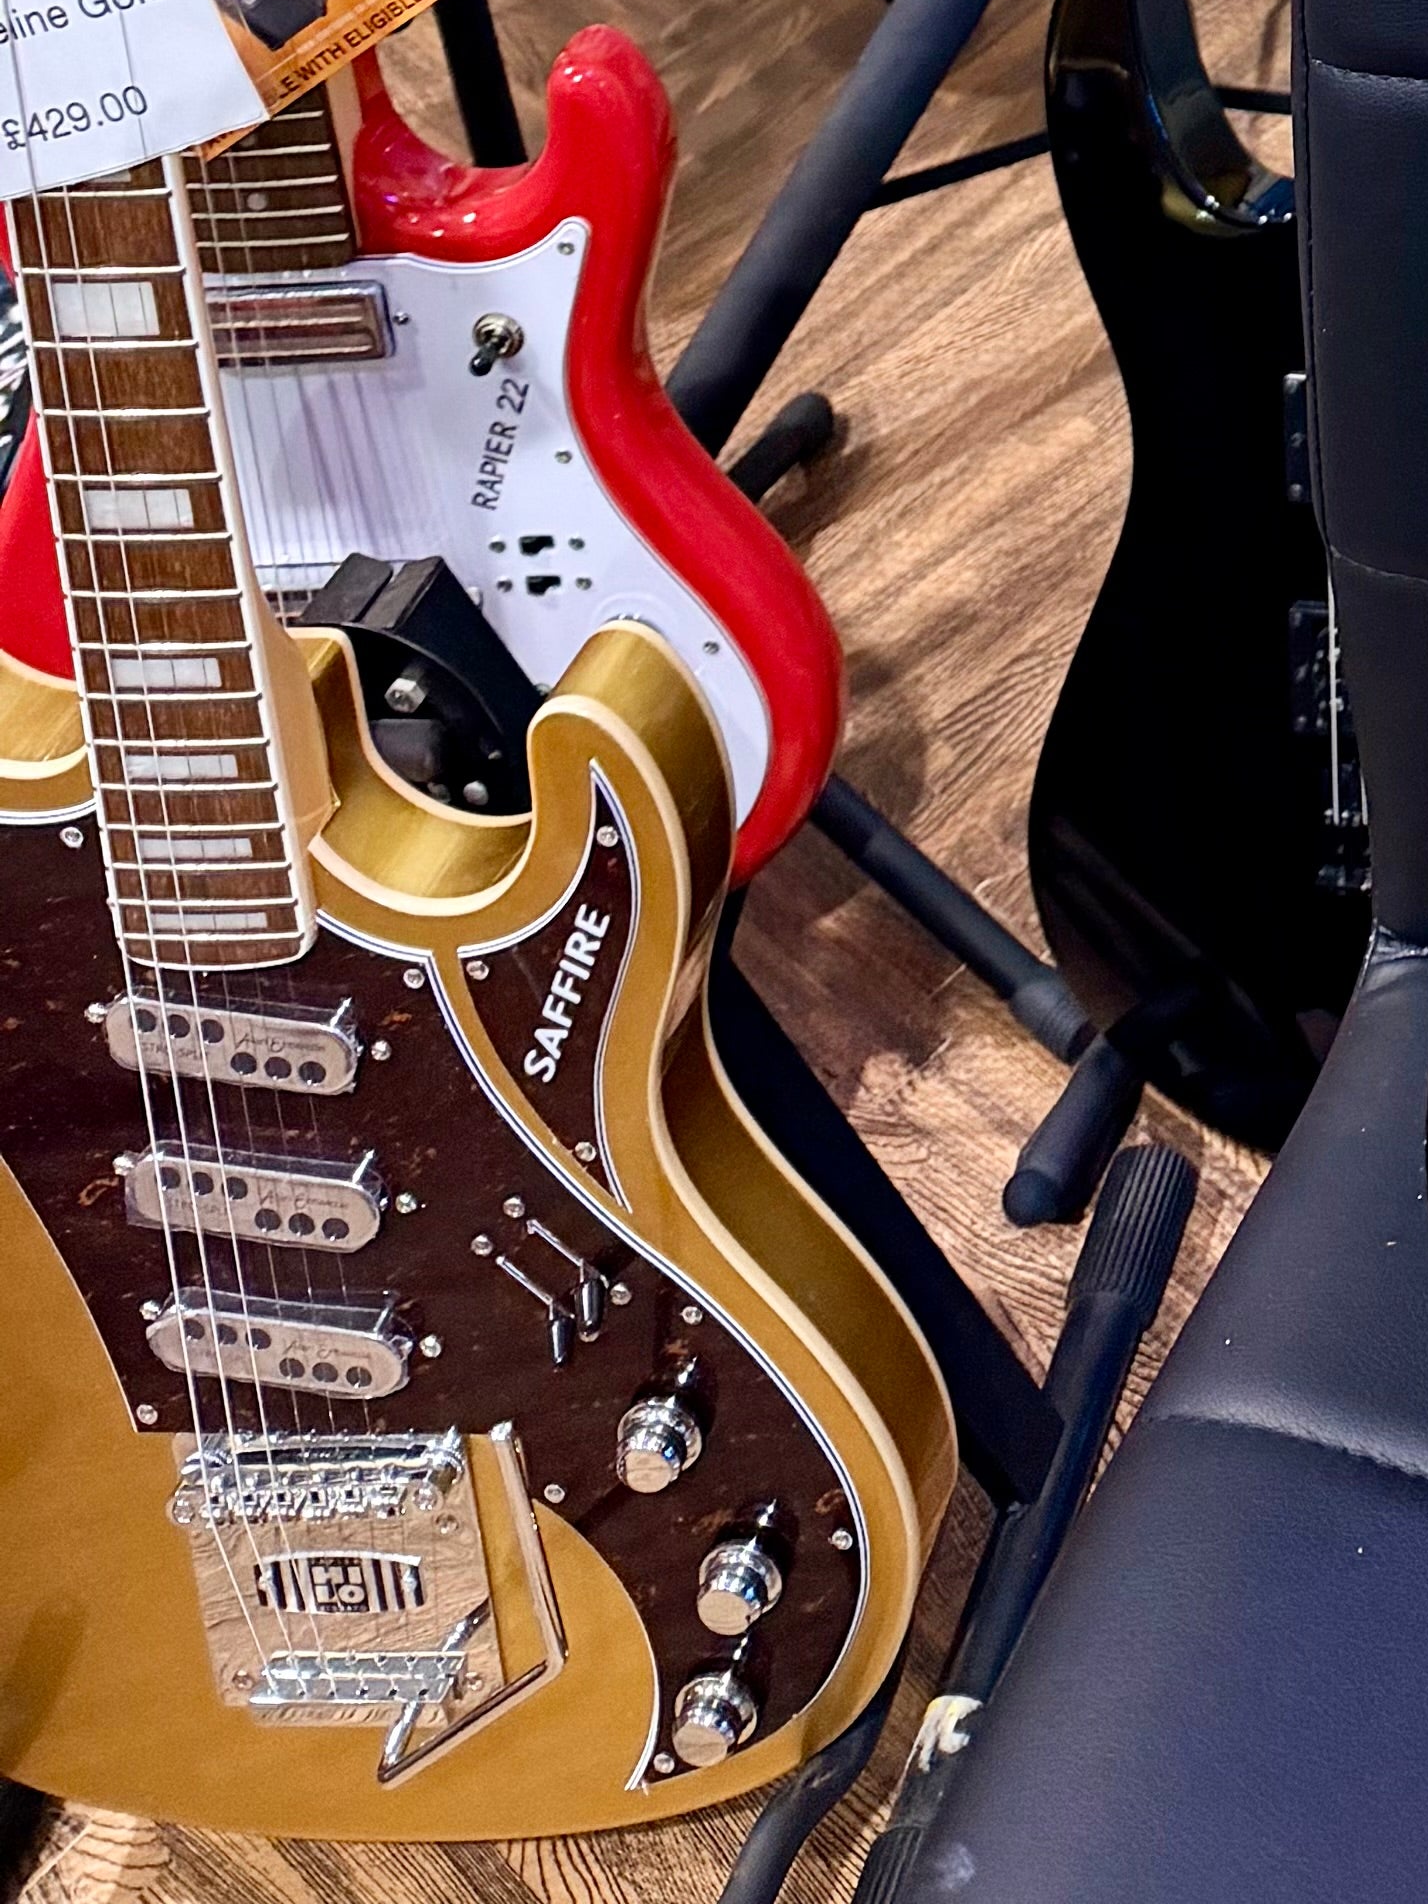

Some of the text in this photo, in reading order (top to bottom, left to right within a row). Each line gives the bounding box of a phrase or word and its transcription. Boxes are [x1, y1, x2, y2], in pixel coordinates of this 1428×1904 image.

[293, 42, 347, 82] WITH
[2, 83, 149, 151] £429.00
[471, 378, 530, 511] RAPIER 22
[524, 903, 611, 1084] SAFFIRE
